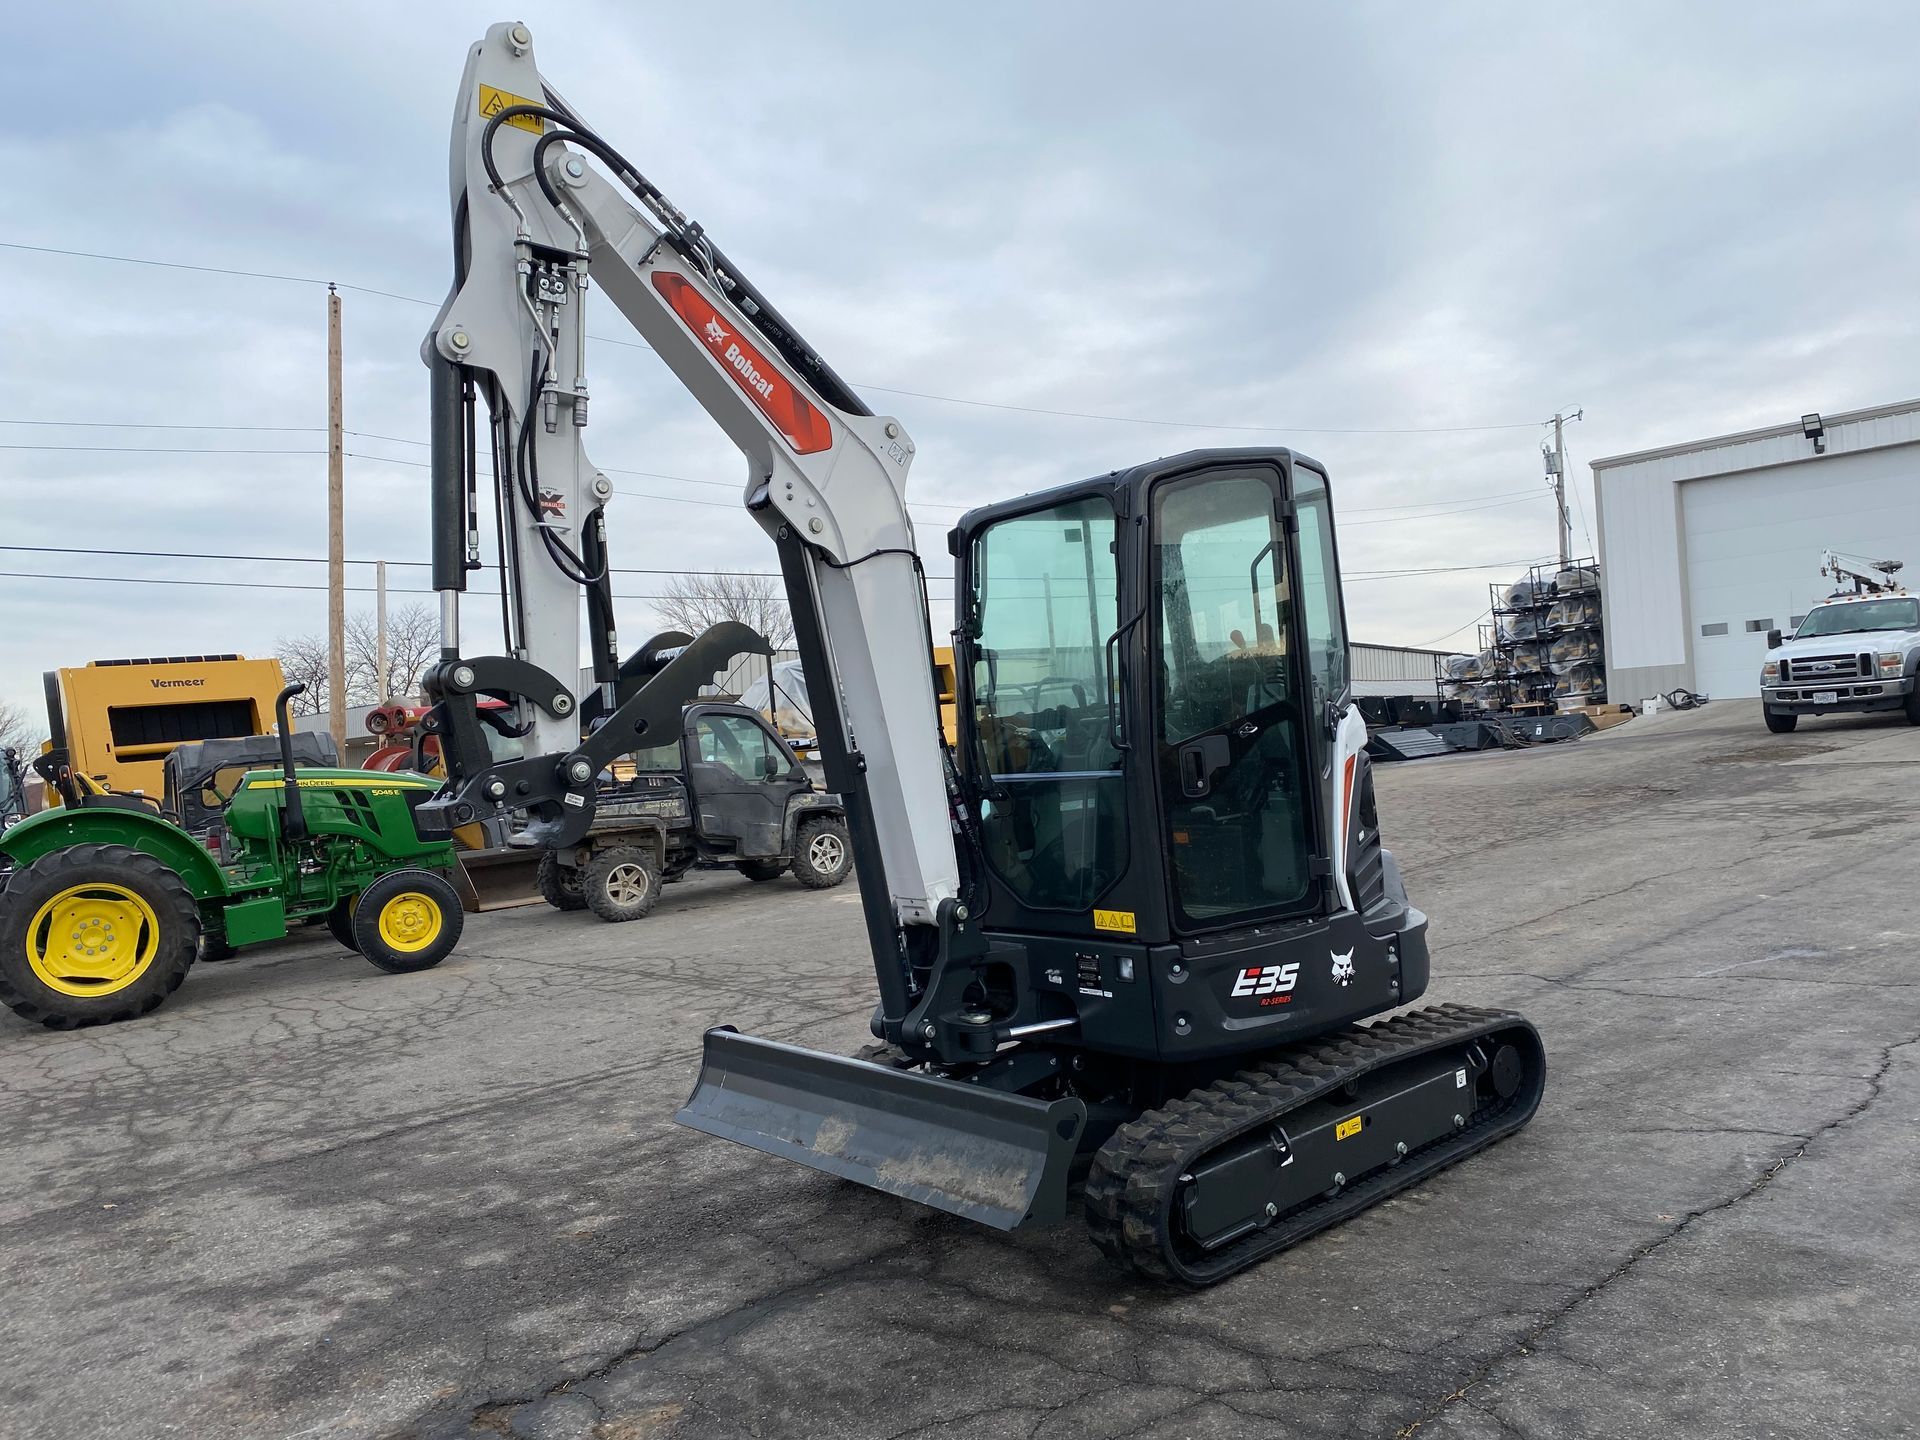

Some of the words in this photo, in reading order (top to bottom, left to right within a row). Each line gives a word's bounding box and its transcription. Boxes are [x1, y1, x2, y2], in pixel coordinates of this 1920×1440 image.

[724, 342, 774, 399] Bobcat
[540, 501, 565, 509] DRAULIC
[150, 679, 205, 688] Vermeer
[1231, 962, 1300, 997] E35
[1260, 995, 1292, 1006] R2-SERIES
